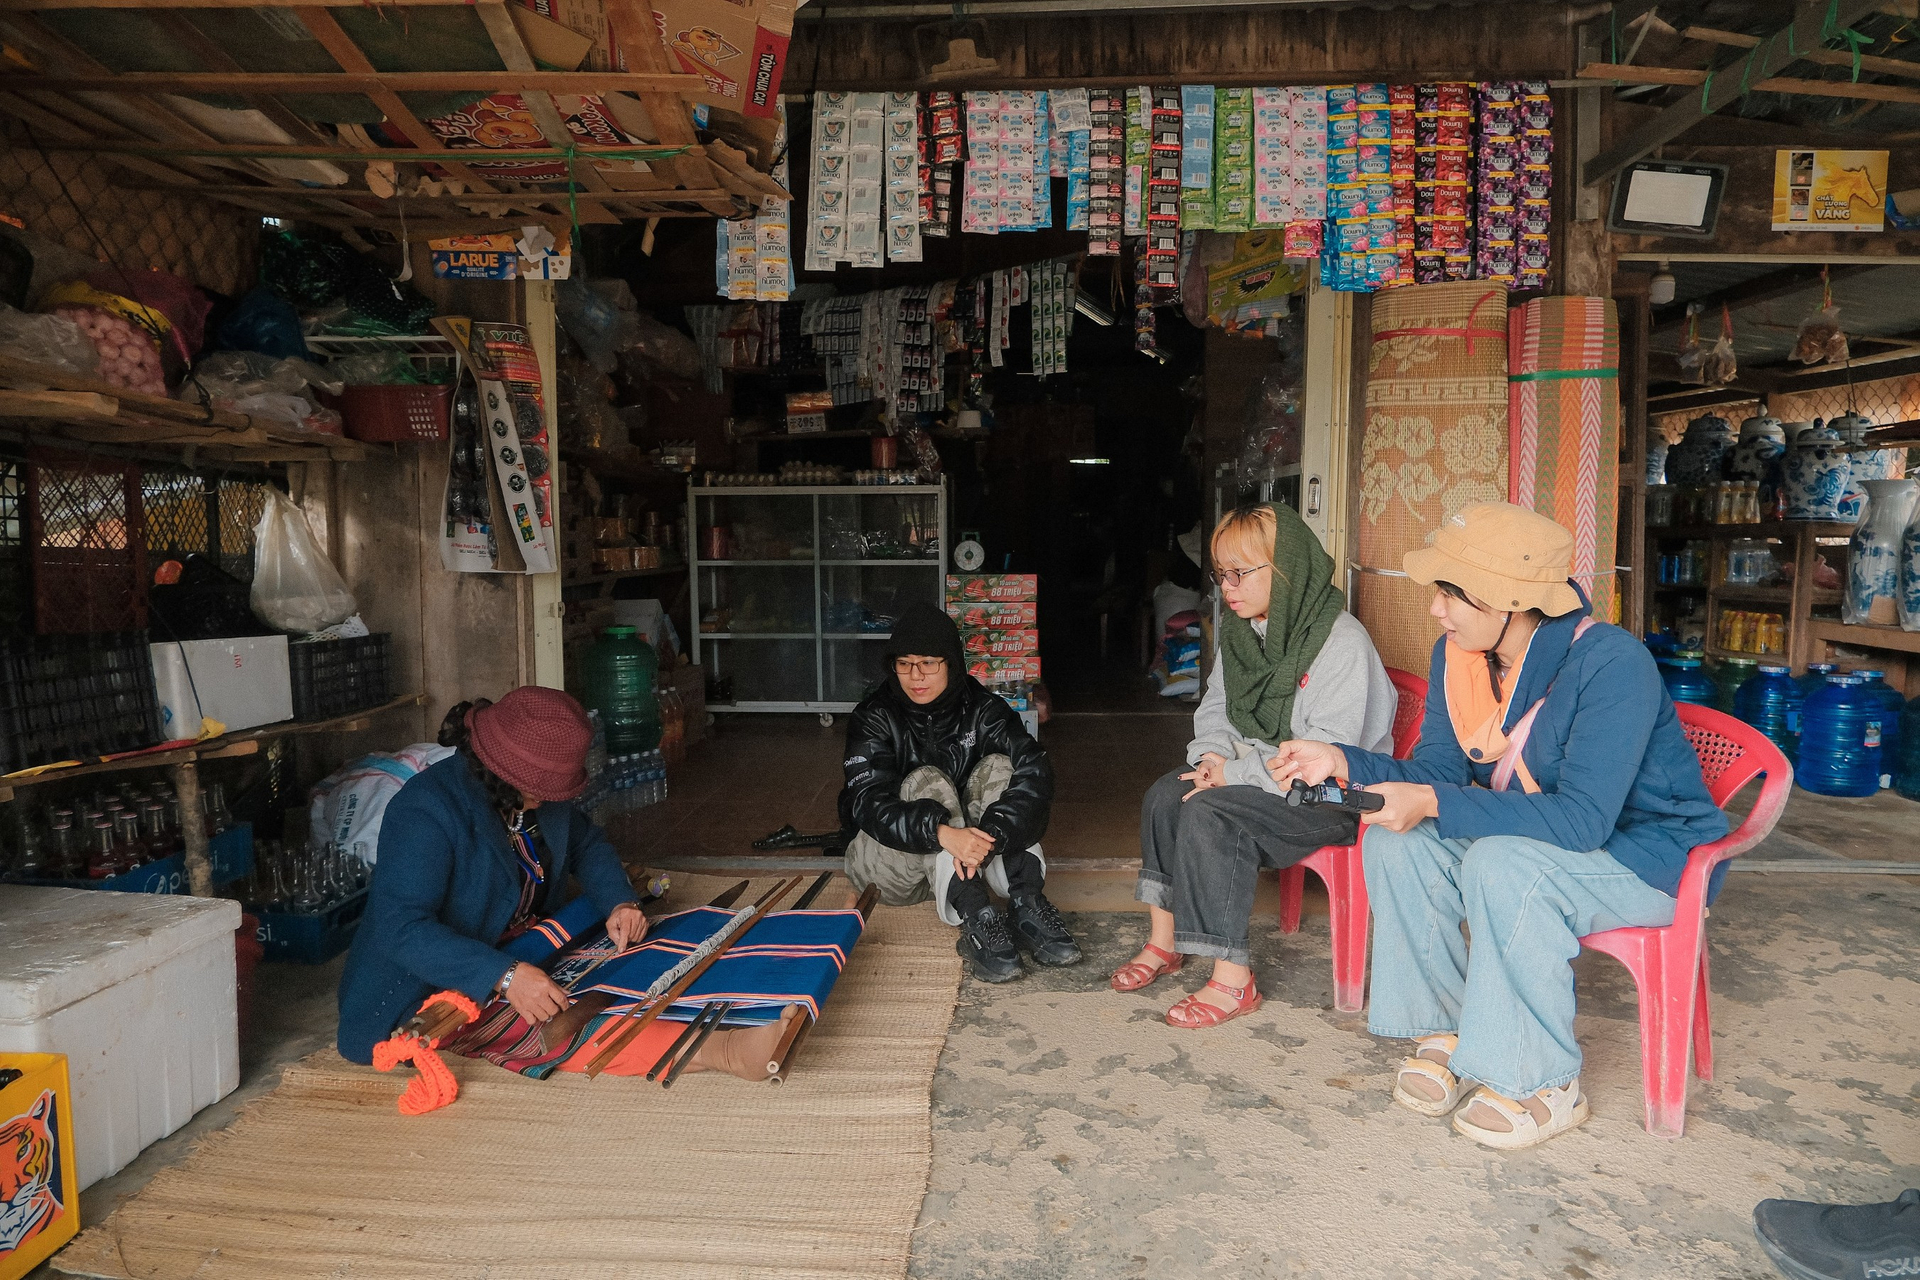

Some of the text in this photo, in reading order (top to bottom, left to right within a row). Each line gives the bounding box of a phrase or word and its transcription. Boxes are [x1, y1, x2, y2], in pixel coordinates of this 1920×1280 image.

[754, 54, 777, 106] TÔM CHUA CAY
[762, 244, 785, 252] Downy
[450, 253, 499, 267] LARUE
[762, 278, 785, 286] Downy
[991, 588, 1021, 597] 88 TRIỆU
[991, 616, 1021, 625] 88 TRIỆU
[1005, 643, 1022, 652] TRIỆU
